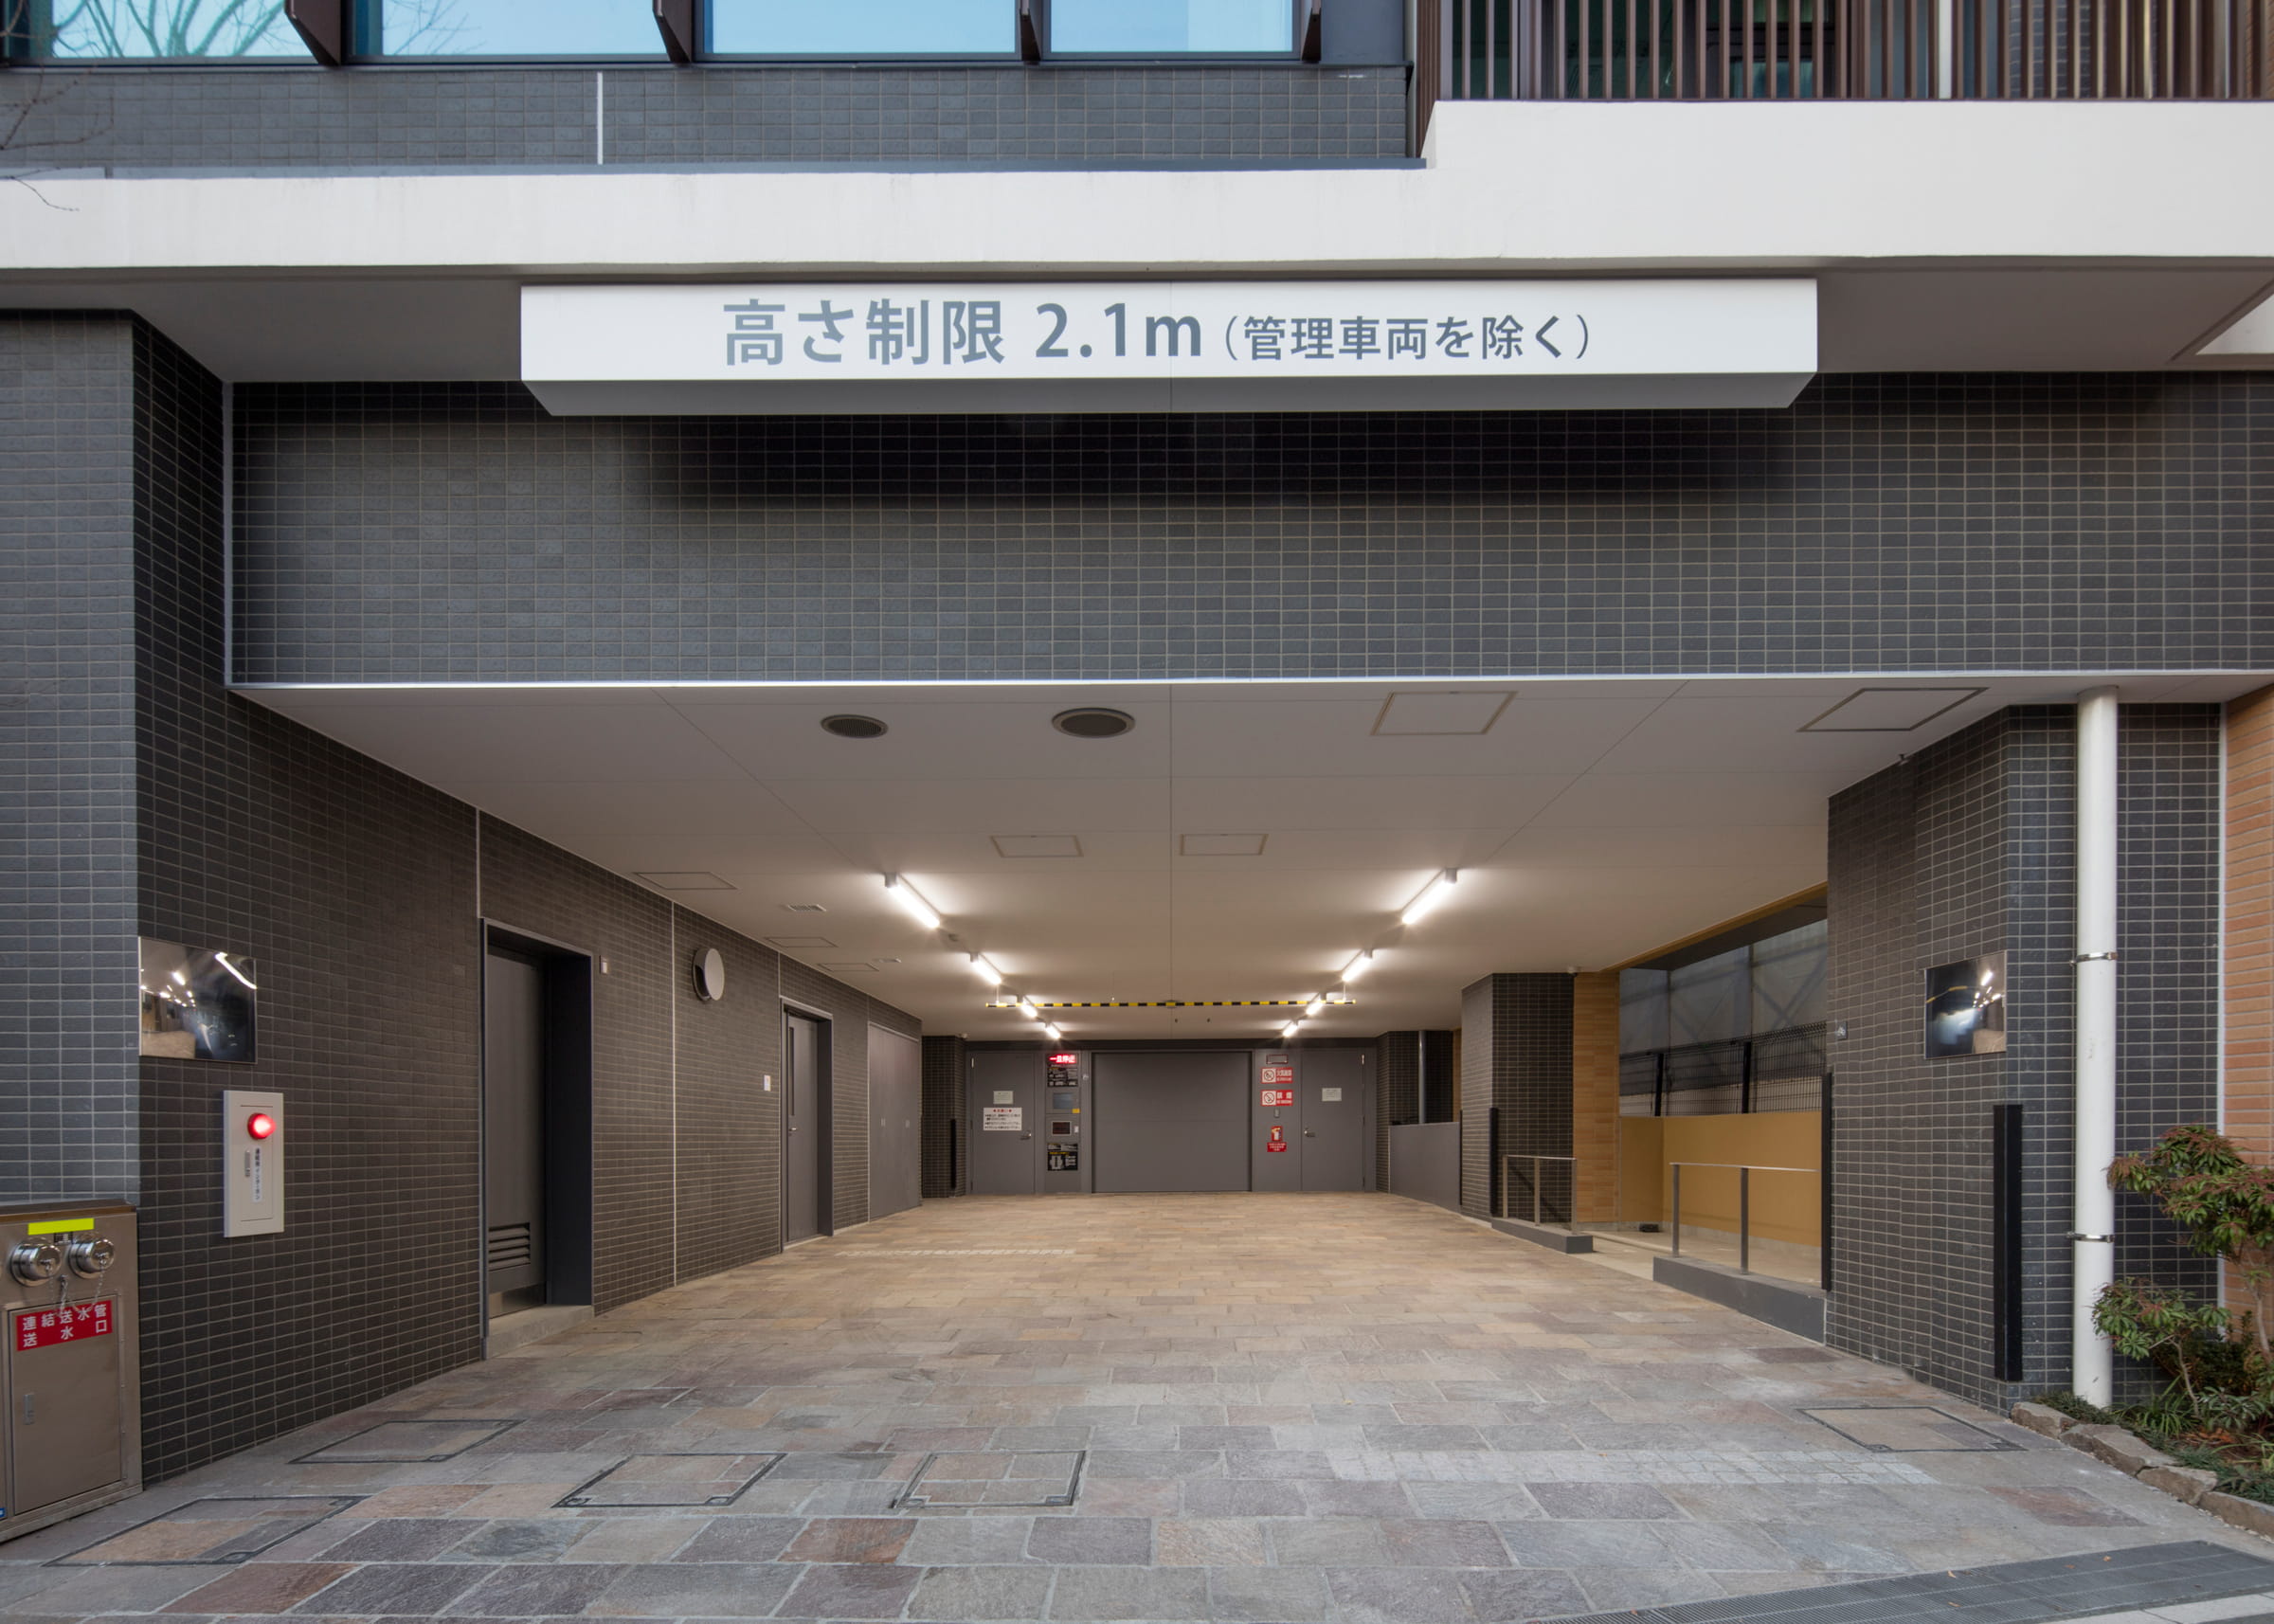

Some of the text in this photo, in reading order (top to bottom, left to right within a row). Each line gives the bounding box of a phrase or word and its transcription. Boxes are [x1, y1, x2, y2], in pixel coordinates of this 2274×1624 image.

[723, 298, 1004, 365] 高さ制限
[1035, 301, 1201, 359] 2.1m
[22, 1303, 107, 1331] 連結送水管
